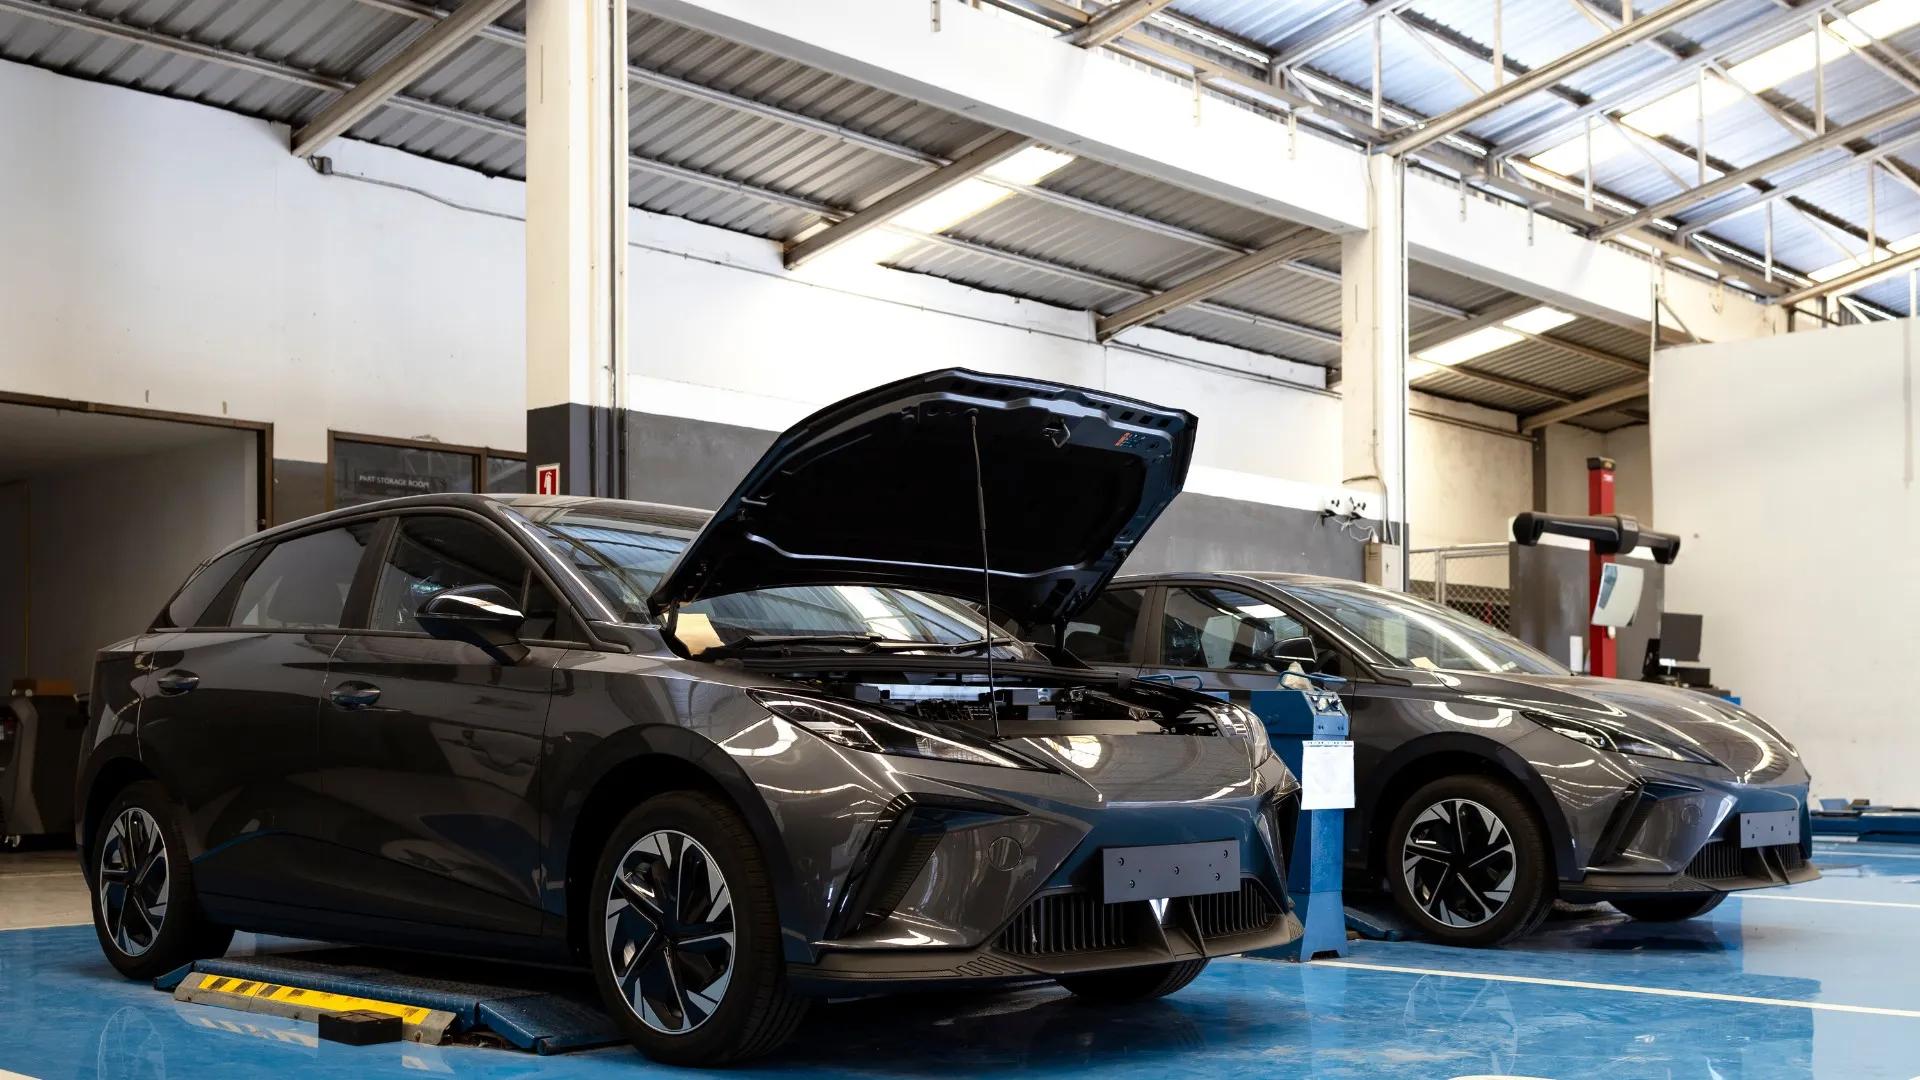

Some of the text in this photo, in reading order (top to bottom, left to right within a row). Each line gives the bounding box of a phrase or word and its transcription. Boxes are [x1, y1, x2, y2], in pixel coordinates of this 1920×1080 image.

[359, 474, 430, 489] PART STORAGE ROOM
